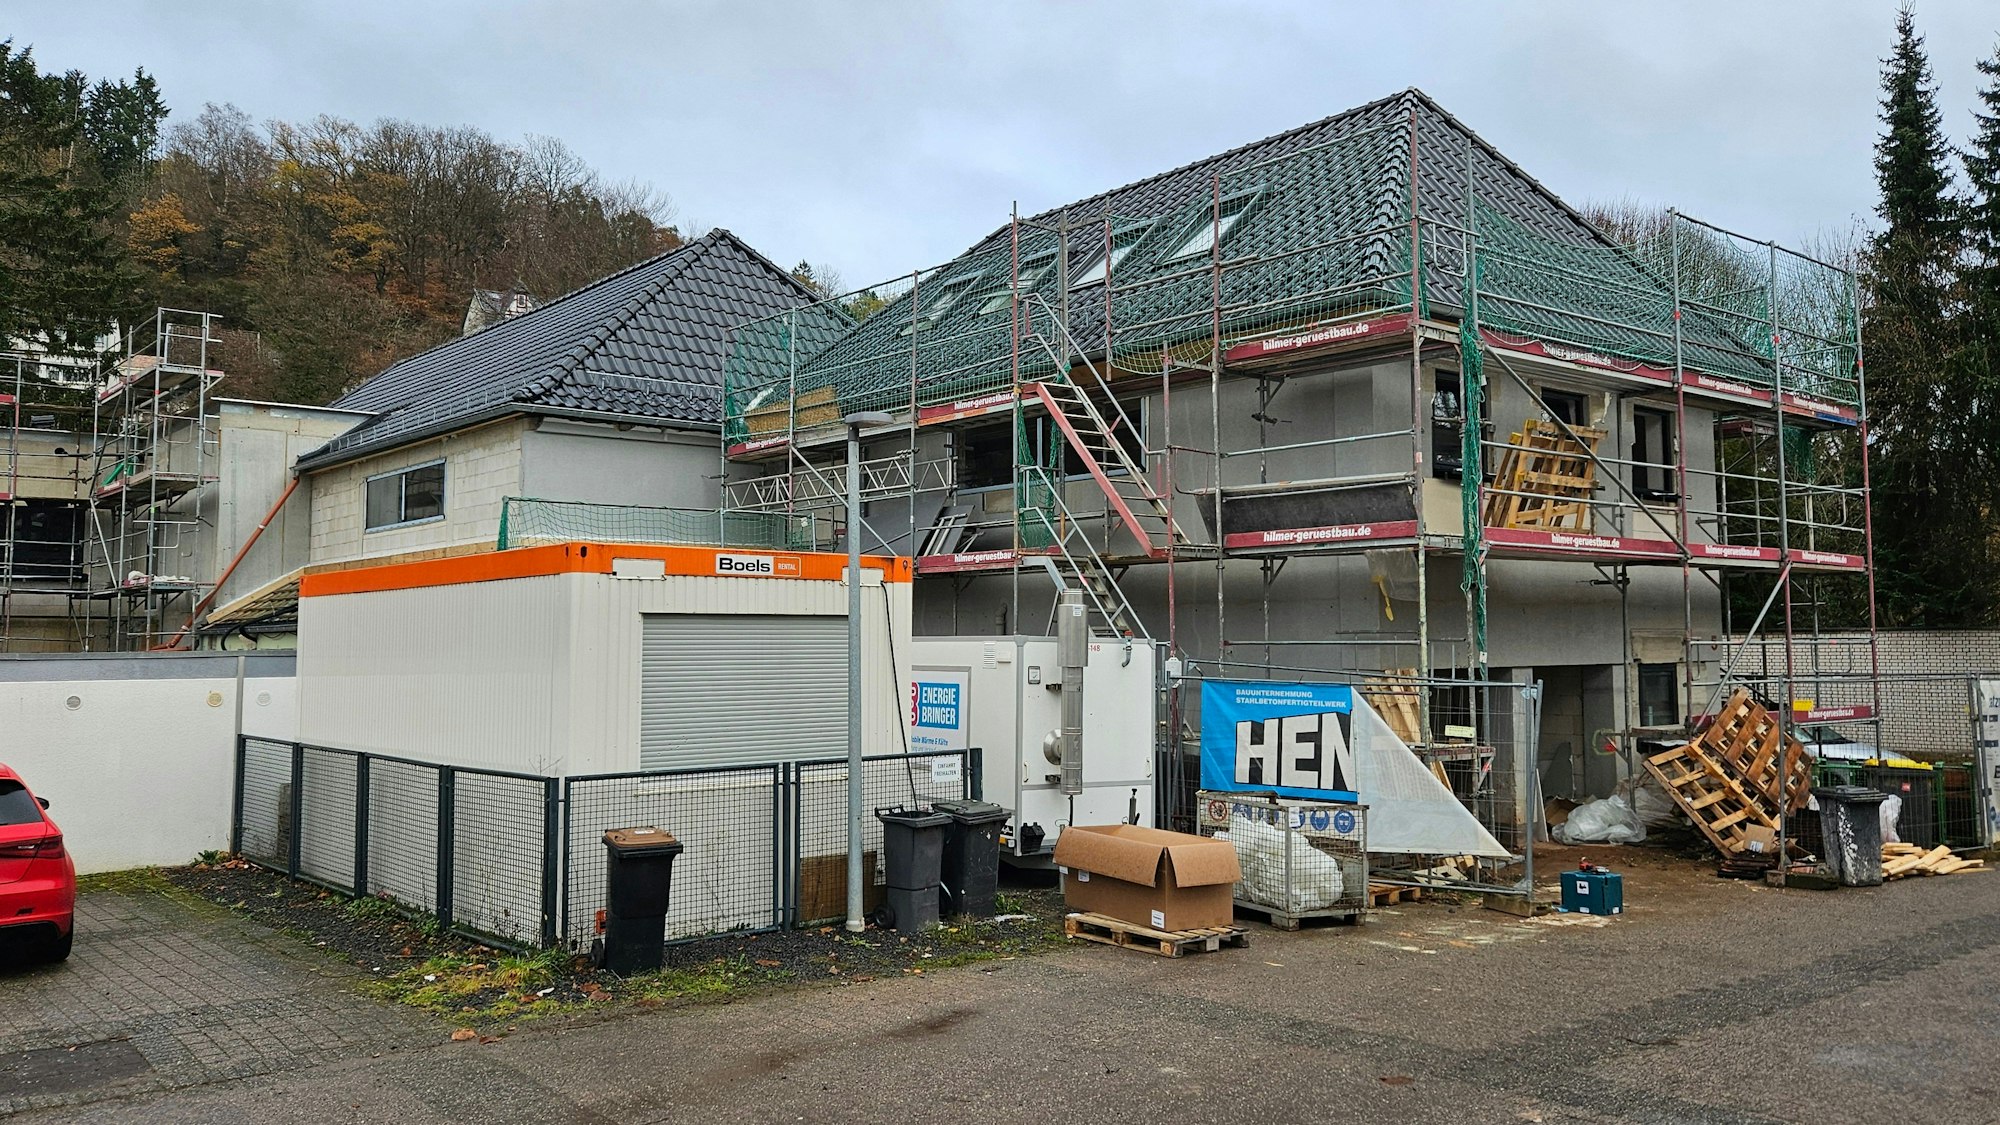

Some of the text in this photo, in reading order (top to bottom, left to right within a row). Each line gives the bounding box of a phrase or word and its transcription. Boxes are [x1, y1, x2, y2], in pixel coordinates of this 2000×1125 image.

[1262, 323, 1370, 351] hilmer-geruestbau.de
[1263, 525, 1372, 543] hilmer-geruestbau.de
[1551, 533, 1620, 549] hilmer-geruestbau.de
[719, 557, 797, 573] Boels RENTAL
[922, 687, 956, 705] ENERGIE
[1236, 689, 1313, 698] BAUUNTERNEHMUNG
[1236, 697, 1347, 708] STAHLBETONFERTIGTEILWERK
[921, 706, 956, 725] BRINGER
